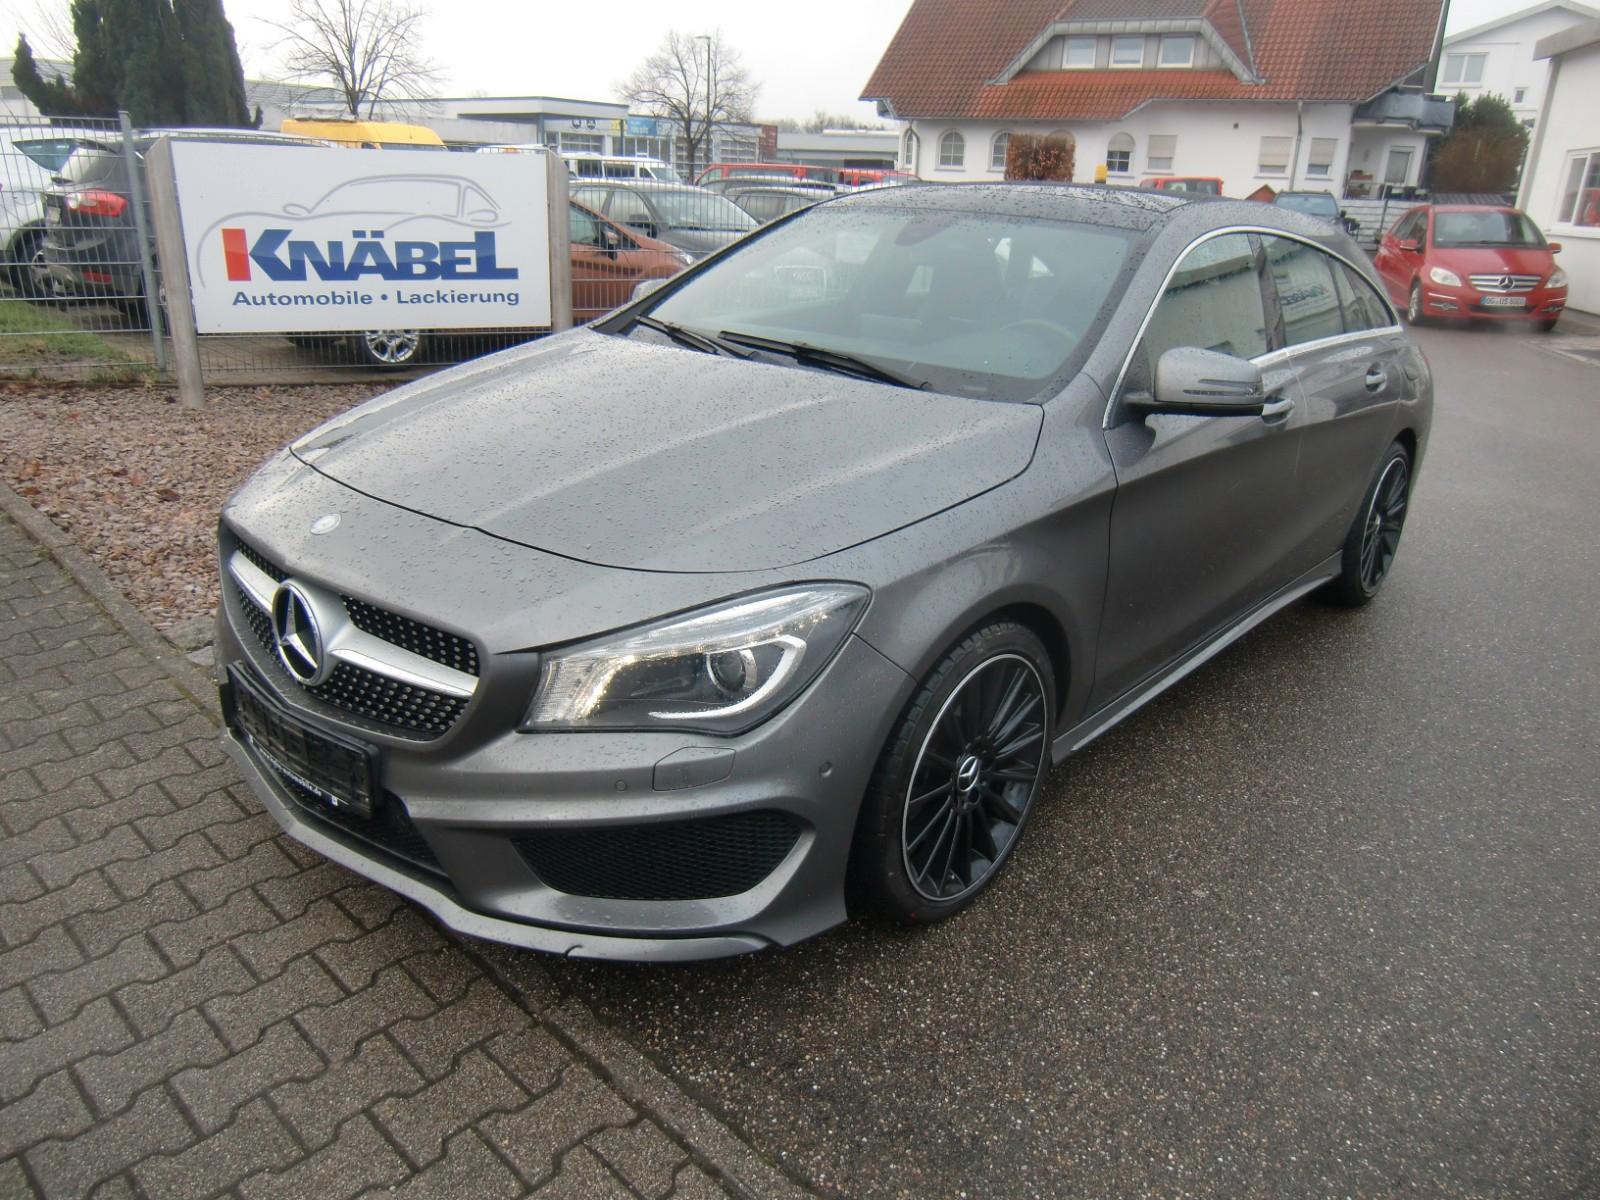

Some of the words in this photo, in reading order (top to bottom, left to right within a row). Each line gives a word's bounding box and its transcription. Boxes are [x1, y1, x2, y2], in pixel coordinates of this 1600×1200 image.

[222, 228, 519, 281] KNÄBEL
[232, 291, 373, 306] Automobile
[396, 290, 519, 306] Lackierung
